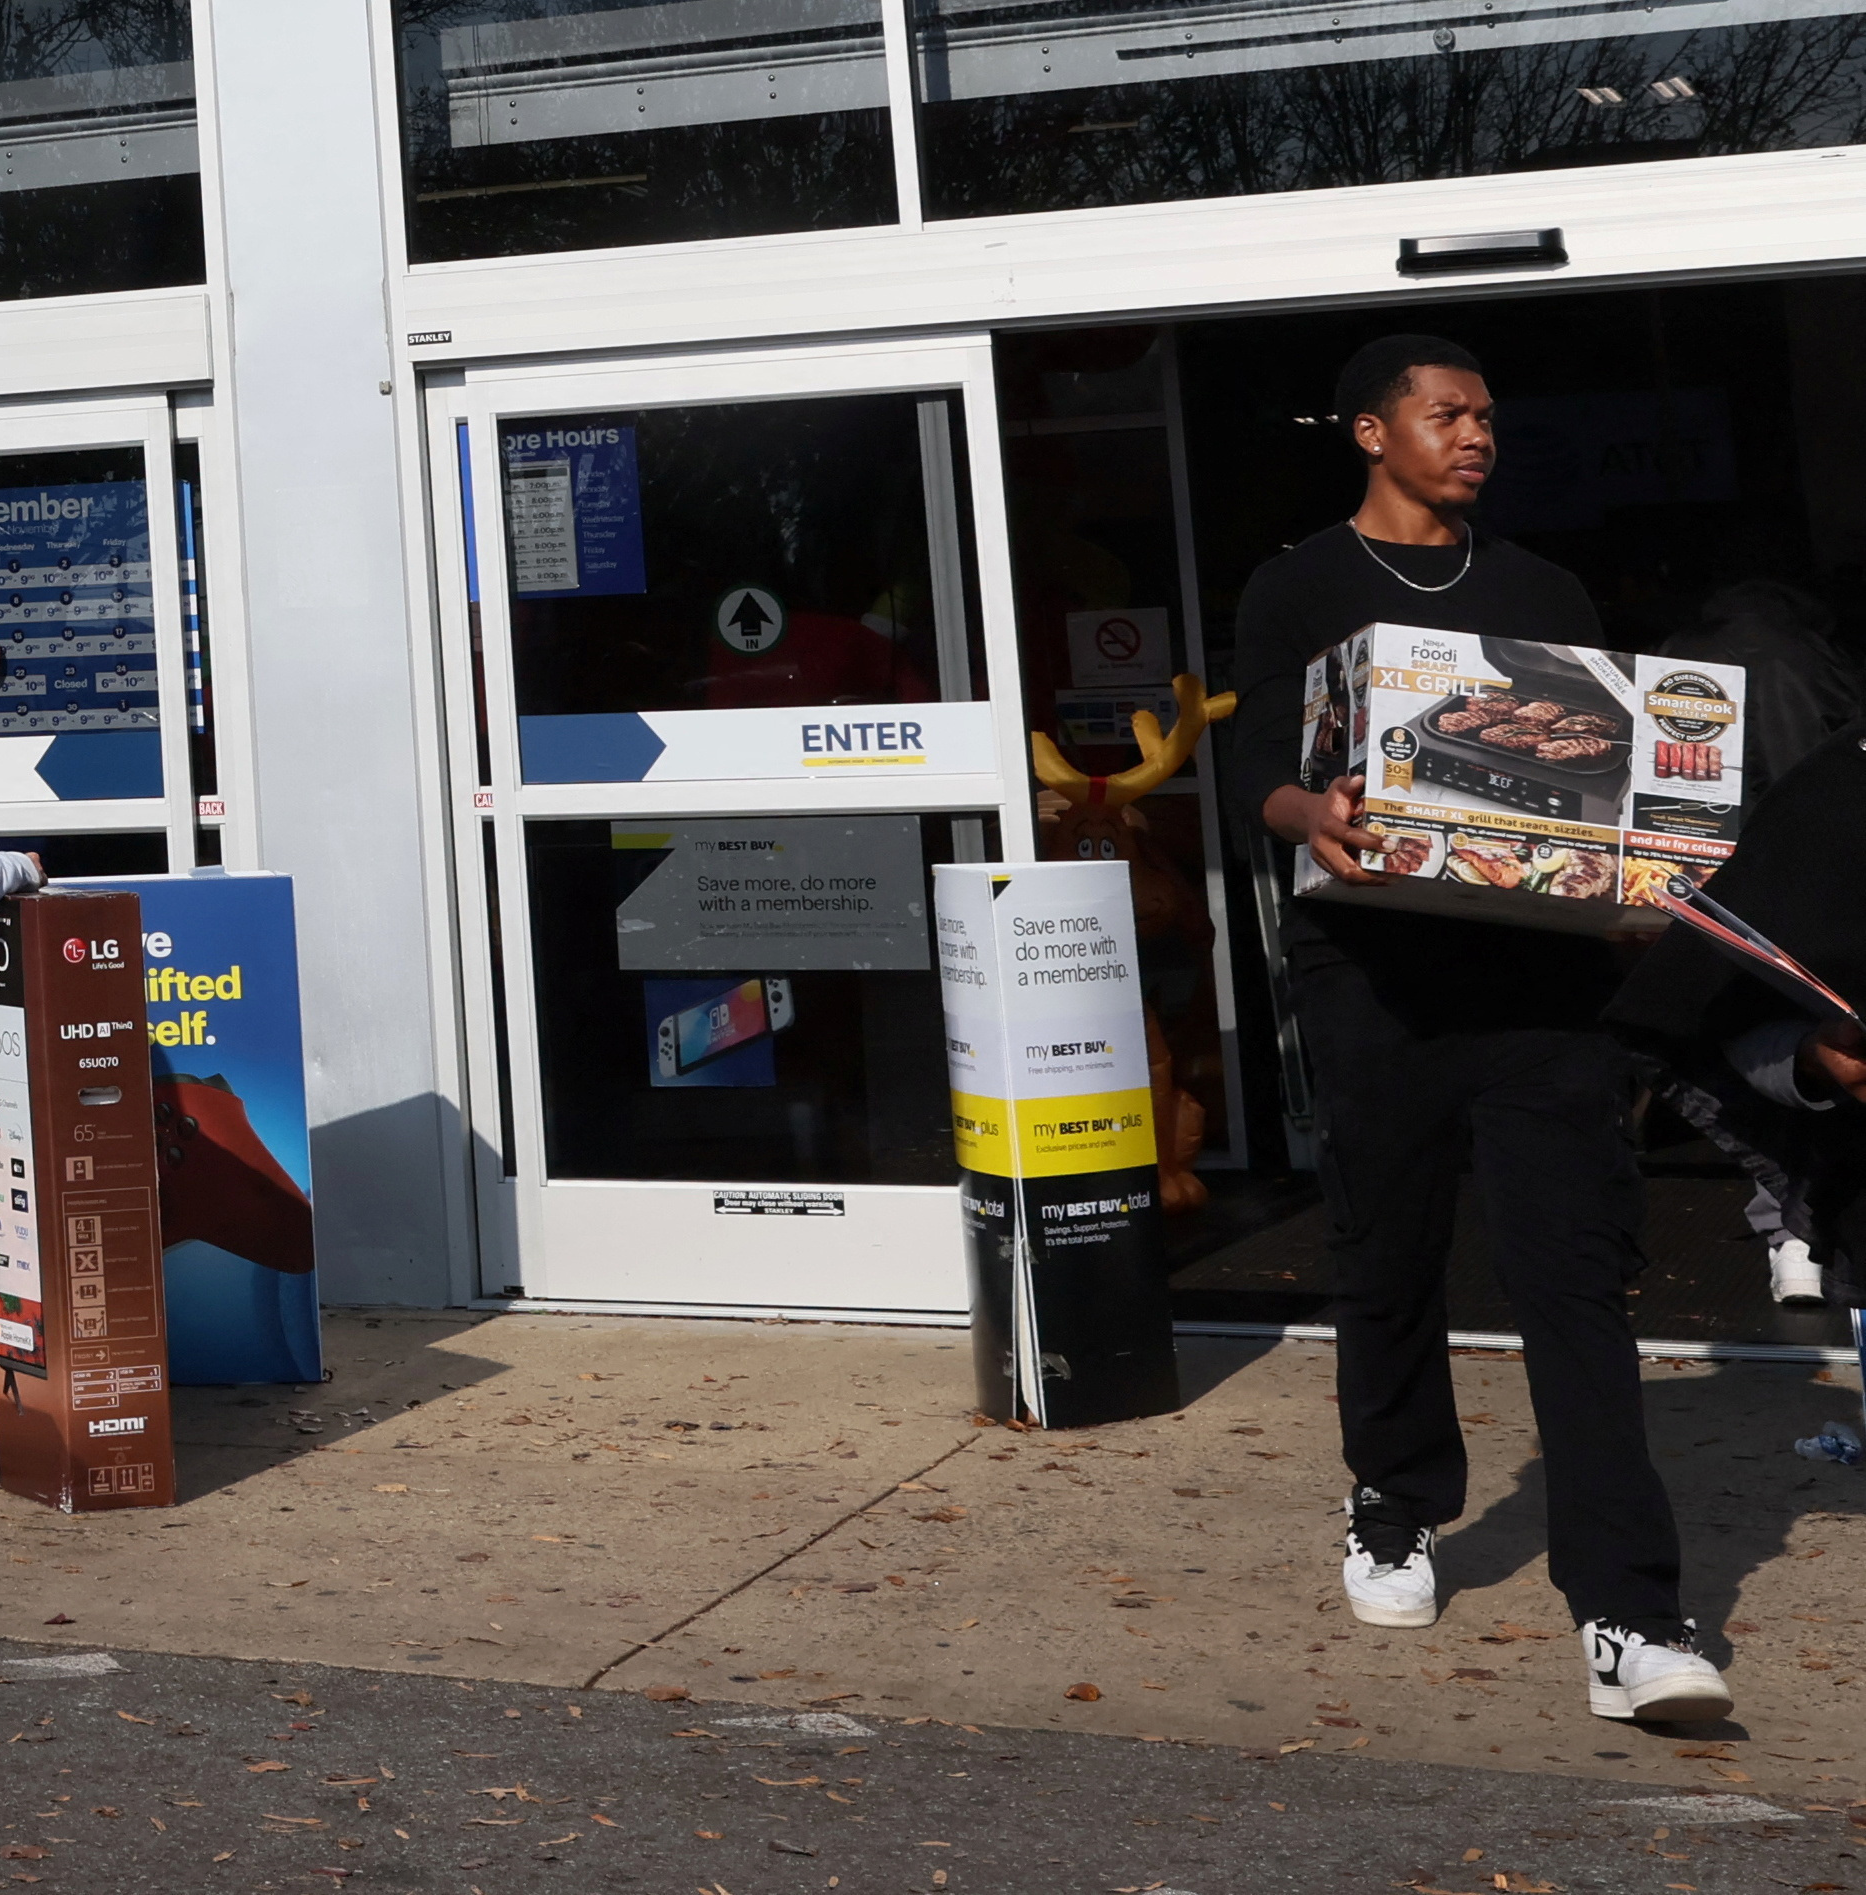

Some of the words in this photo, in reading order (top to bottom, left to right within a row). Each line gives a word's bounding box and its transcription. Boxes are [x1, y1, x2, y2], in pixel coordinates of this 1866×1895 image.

[408, 332, 451, 344] STANLEY
[505, 433, 541, 450] ore
[545, 427, 620, 448] Hours
[1599, 438, 1711, 478] ATT
[102, 538, 127, 547] Friday
[583, 530, 617, 539] Thursday
[745, 639, 759, 649] IN
[1423, 639, 1445, 648] NINJA
[1411, 645, 1457, 662] Foodi
[1411, 660, 1458, 674] SMART
[1597, 656, 1630, 688] VIRTUALLY
[54, 678, 88, 689] Closed
[1379, 670, 1410, 689] XL
[1417, 675, 1488, 698] GRILL
[1589, 657, 1628, 696] SMOKE-FREE
[1662, 678, 1673, 688] NO
[1673, 674, 1720, 694] GUESSWORK
[1648, 695, 1691, 711] Smart
[1694, 700, 1733, 715] Cook
[802, 721, 924, 752] ENTER
[1392, 728, 1405, 742] 6
[1658, 718, 1686, 741] PERFECT
[1686, 725, 1721, 742] DONENESS
[1385, 764, 1410, 776] 50%
[1488, 773, 1514, 788] BEEF
[199, 803, 223, 815] BACK
[1383, 802, 1404, 813] The
[1405, 804, 1446, 818] SMART
[1450, 808, 1465, 821] XL
[1467, 814, 1492, 826] grill
[1494, 816, 1517, 828] that
[1519, 821, 1552, 834] sears,
[695, 841, 715, 854] my
[718, 841, 747, 851] BEST
[751, 841, 775, 850] BUY
[1630, 834, 1652, 846] and
[1655, 836, 1672, 848] air
[1672, 838, 1689, 852] fry
[697, 876, 740, 891] Save
[745, 878, 795, 892] more,
[801, 875, 824, 890] do
[830, 877, 876, 891] more
[699, 896, 735, 911] with
[741, 899, 751, 911] a
[756, 895, 873, 913] membership.
[1013, 916, 1055, 936] Save
[1060, 915, 1102, 933] more,
[91, 939, 119, 960] LG
[959, 941, 978, 961] with
[1015, 942, 1040, 961] do
[1045, 942, 1087, 960] more
[1090, 936, 1117, 955] with
[92, 962, 108, 970] Life's
[108, 961, 125, 969] Good
[1018, 972, 1028, 986] a
[1034, 959, 1129, 985] membership.
[145, 965, 242, 1002] ifted
[60, 1023, 94, 1040] UHD
[112, 1021, 133, 1031] ThinQ
[1026, 1045, 1049, 1061] my
[1052, 1043, 1082, 1057] BEST
[1085, 1040, 1106, 1054] BUY
[78, 1056, 119, 1069] 65UQ70
[1028, 1066, 1043, 1075] Free
[1075, 1063, 1084, 1071] no
[981, 1119, 999, 1137] plus
[1034, 1122, 1057, 1138] my
[1059, 1120, 1089, 1135] BEST
[1093, 1117, 1113, 1131] BUY
[1121, 1112, 1143, 1131] plus
[1036, 1144, 1067, 1154] Exclusive
[1067, 1142, 1087, 1152] prices
[1088, 1140, 1100, 1149] and
[742, 1200, 756, 1208] may
[778, 1200, 804, 1208] without
[805, 1201, 835, 1210] warning
[748, 1191, 792, 1200] AUTOMATIC
[792, 1192, 822, 1201] SLIDING
[822, 1193, 844, 1201] DOOR
[985, 1198, 1005, 1218] total
[1042, 1205, 1065, 1221] my
[1067, 1201, 1098, 1217] BEST
[1101, 1199, 1121, 1212] BUY
[1128, 1191, 1151, 1210] total
[1044, 1226, 1072, 1237] Savings.
[1073, 1222, 1101, 1233] Support.
[1056, 1236, 1067, 1245] the
[1067, 1235, 1083, 1245] total
[1083, 1232, 1111, 1244] package.
[88, 1416, 145, 1435] HDMI
